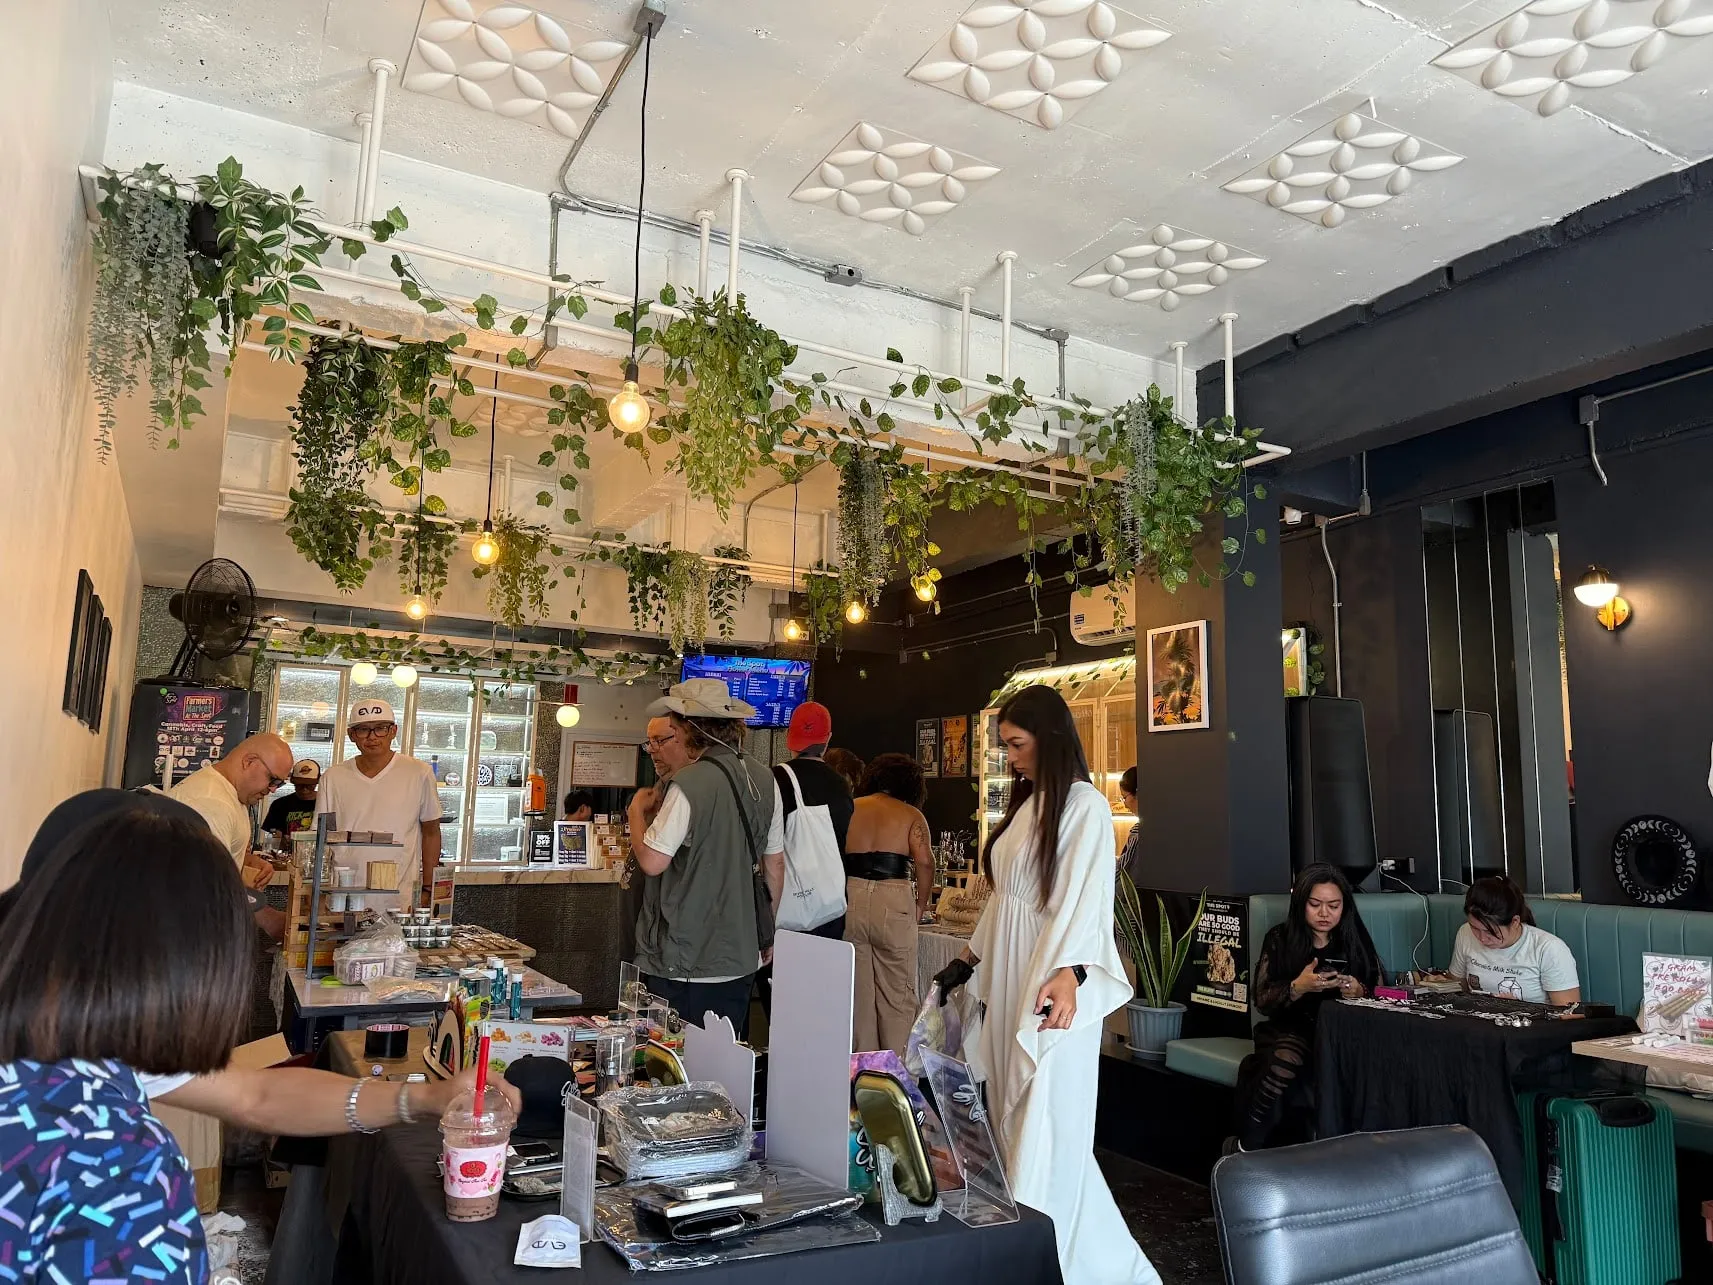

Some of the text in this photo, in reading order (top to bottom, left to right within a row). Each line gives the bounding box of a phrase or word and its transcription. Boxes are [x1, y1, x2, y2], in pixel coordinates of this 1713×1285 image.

[1217, 915, 1240, 925] BUDS
[1197, 932, 1242, 948] ILLEGAL
[1668, 964, 1696, 972] GRAM
[1672, 976, 1705, 984] ROLLS
